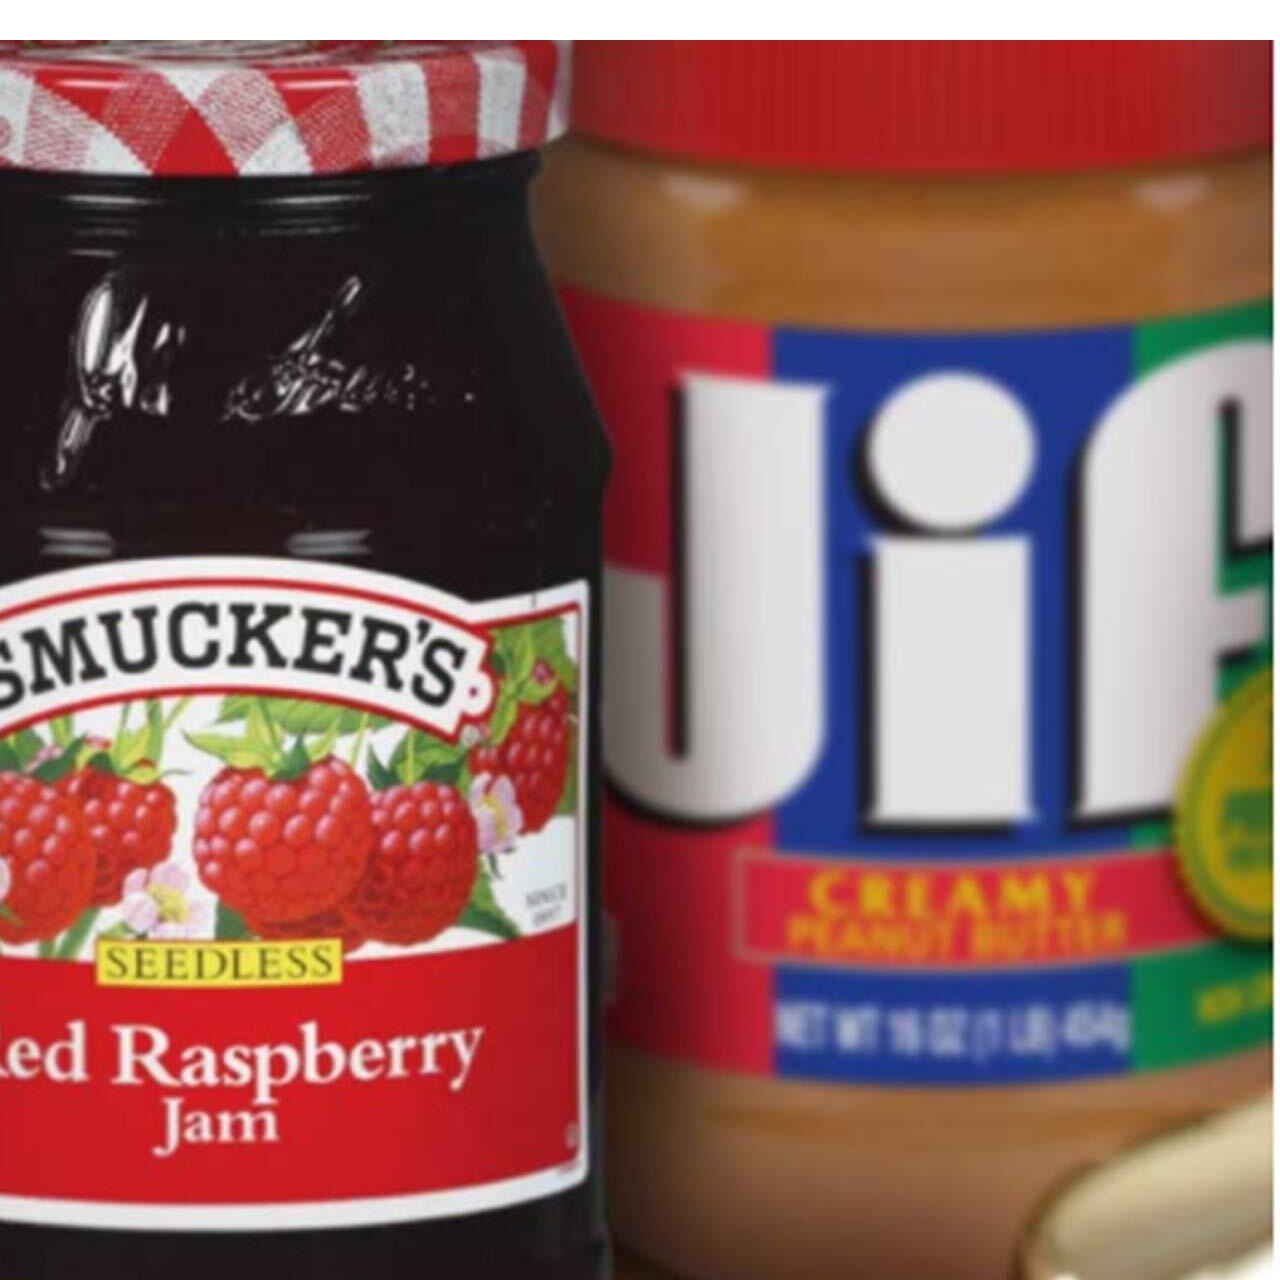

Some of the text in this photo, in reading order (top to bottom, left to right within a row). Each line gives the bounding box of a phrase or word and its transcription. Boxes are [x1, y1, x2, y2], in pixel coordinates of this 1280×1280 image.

[808, 866, 1096, 920] CREAMY
[105, 943, 335, 982] SEEDLESS
[110, 1019, 486, 1106] Raspberry
[151, 1098, 280, 1157] Jam
